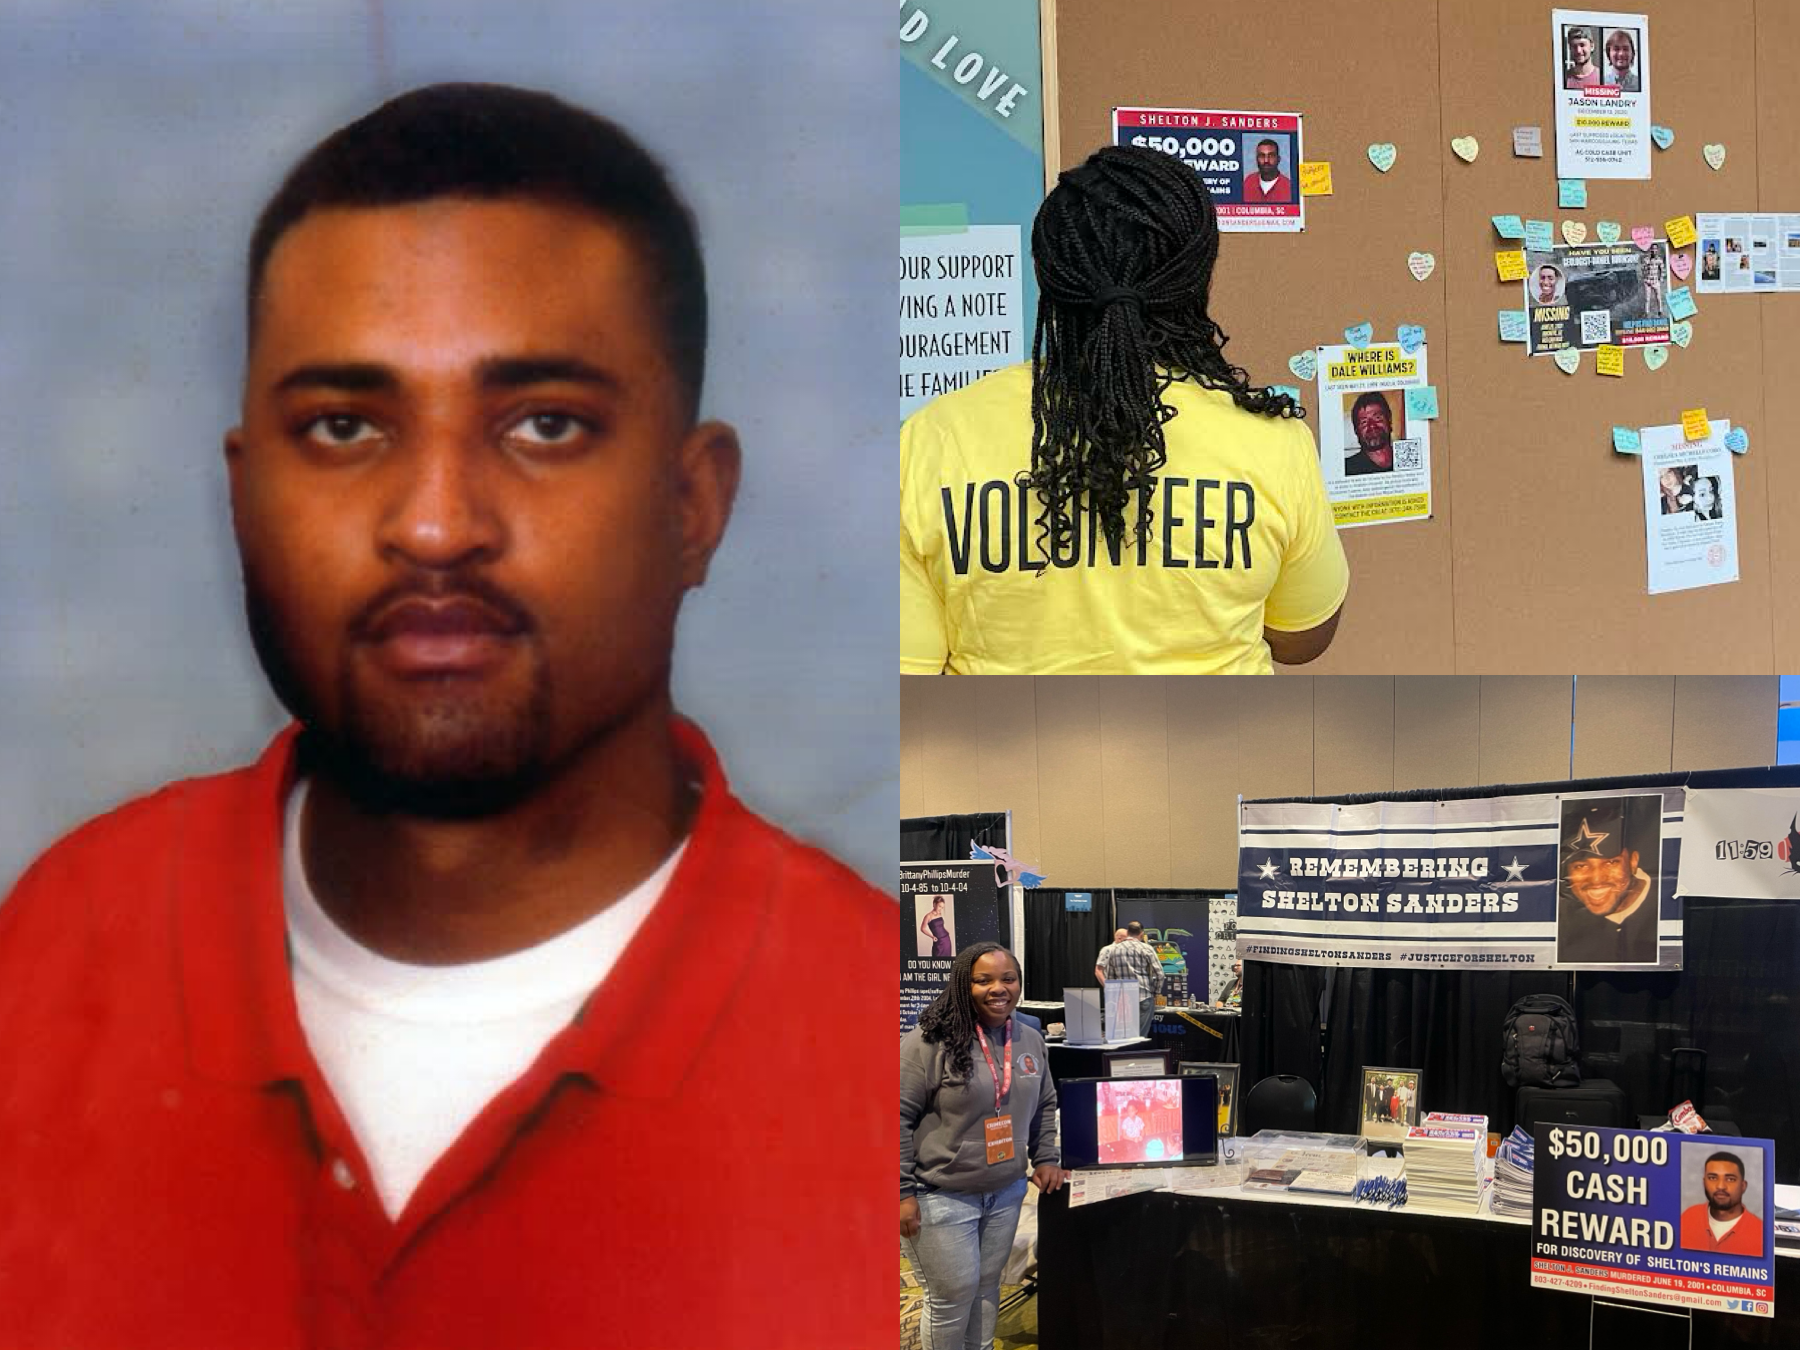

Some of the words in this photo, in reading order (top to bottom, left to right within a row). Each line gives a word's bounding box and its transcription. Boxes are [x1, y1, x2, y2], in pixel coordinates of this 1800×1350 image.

[900, 0, 929, 42] D
[931, 35, 1028, 117] LOVE
[1584, 87, 1620, 96] MISSING
[1568, 98, 1598, 106] JASON
[1600, 99, 1637, 108] LANDRY
[1139, 115, 1198, 126] SHELTON
[1205, 116, 1215, 126] J.
[1222, 117, 1278, 128] SANDERS
[1131, 134, 1236, 158] $50,000
[938, 255, 1014, 279] SUPPORT
[944, 294, 956, 317] A
[962, 292, 1007, 317] NOTE
[1534, 307, 1570, 322] MISSING
[1347, 351, 1382, 363] WHERE
[1385, 351, 1395, 361] IS
[1331, 366, 1356, 377] DALE
[1360, 362, 1414, 375] WILLIAMS?
[941, 476, 1256, 575] VOLUNTEER
[1716, 840, 1773, 860] 11:59
[1289, 857, 1488, 878] REMEMBERING
[931, 884, 939, 892] to
[940, 883, 968, 892] 10-4-04
[1261, 890, 1380, 913] SHELTON
[1386, 892, 1519, 914] SANDERS
[907, 960, 917, 969] DO
[917, 960, 931, 969] YOU
[931, 960, 952, 969] KNOW
[1246, 945, 1392, 961] #FINDINGSHELTONSANDERS
[1400, 953, 1535, 963] #JUSTICEFORSHELTON
[902, 973, 913, 982] AM
[914, 973, 926, 982] THE
[927, 973, 942, 982] GIRL
[1152, 1023, 1187, 1035] ious
[1548, 1127, 1668, 1165] $50,000
[1566, 1170, 1647, 1205] CASH
[1541, 1208, 1674, 1250] REWARD
[1536, 1242, 1558, 1255] FOR
[1561, 1246, 1622, 1263] DISCOVERY
[1625, 1254, 1641, 1265] OF
[1647, 1256, 1711, 1274] SHELTON'S
[1714, 1264, 1768, 1281] REMAINS
[1534, 1261, 1565, 1272] SHELTON
[1566, 1265, 1574, 1274] J.
[1575, 1267, 1609, 1277] SANDERS
[1610, 1271, 1651, 1283] MURDERED
[1653, 1277, 1672, 1286] JUNE
[1674, 1279, 1685, 1289] 19,
[1687, 1281, 1705, 1290] 2001
[1711, 1283, 1754, 1297] COLUMBIA,
[1756, 1289, 1767, 1297] SC
[1534, 1275, 1583, 1288] 803-427-4209
[1588, 1282, 1722, 1307] FindingSheltonSanders@gmail.com
